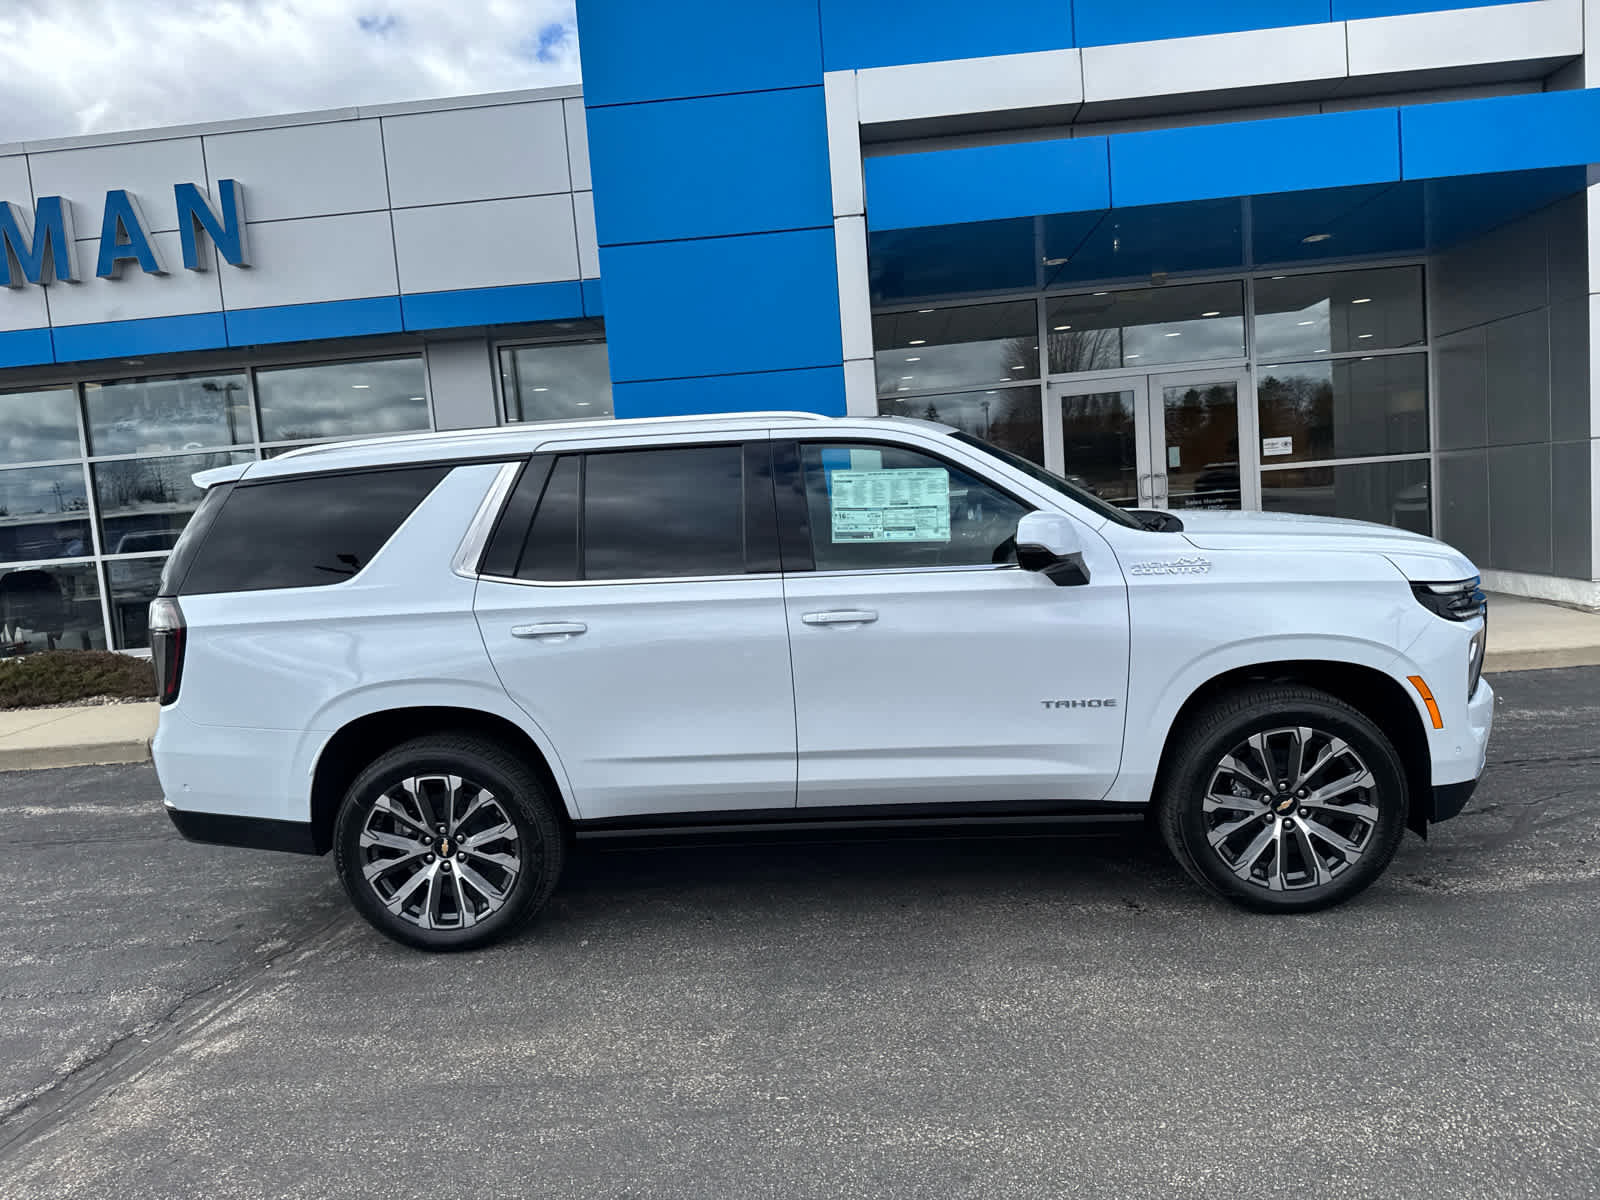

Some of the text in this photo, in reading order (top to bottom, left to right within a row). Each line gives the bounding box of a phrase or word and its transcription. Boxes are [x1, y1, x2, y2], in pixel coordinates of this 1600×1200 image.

[0, 179, 247, 287] MAN
[1131, 566, 1209, 576] COUNTRY
[1040, 699, 1117, 709] TAHOE
